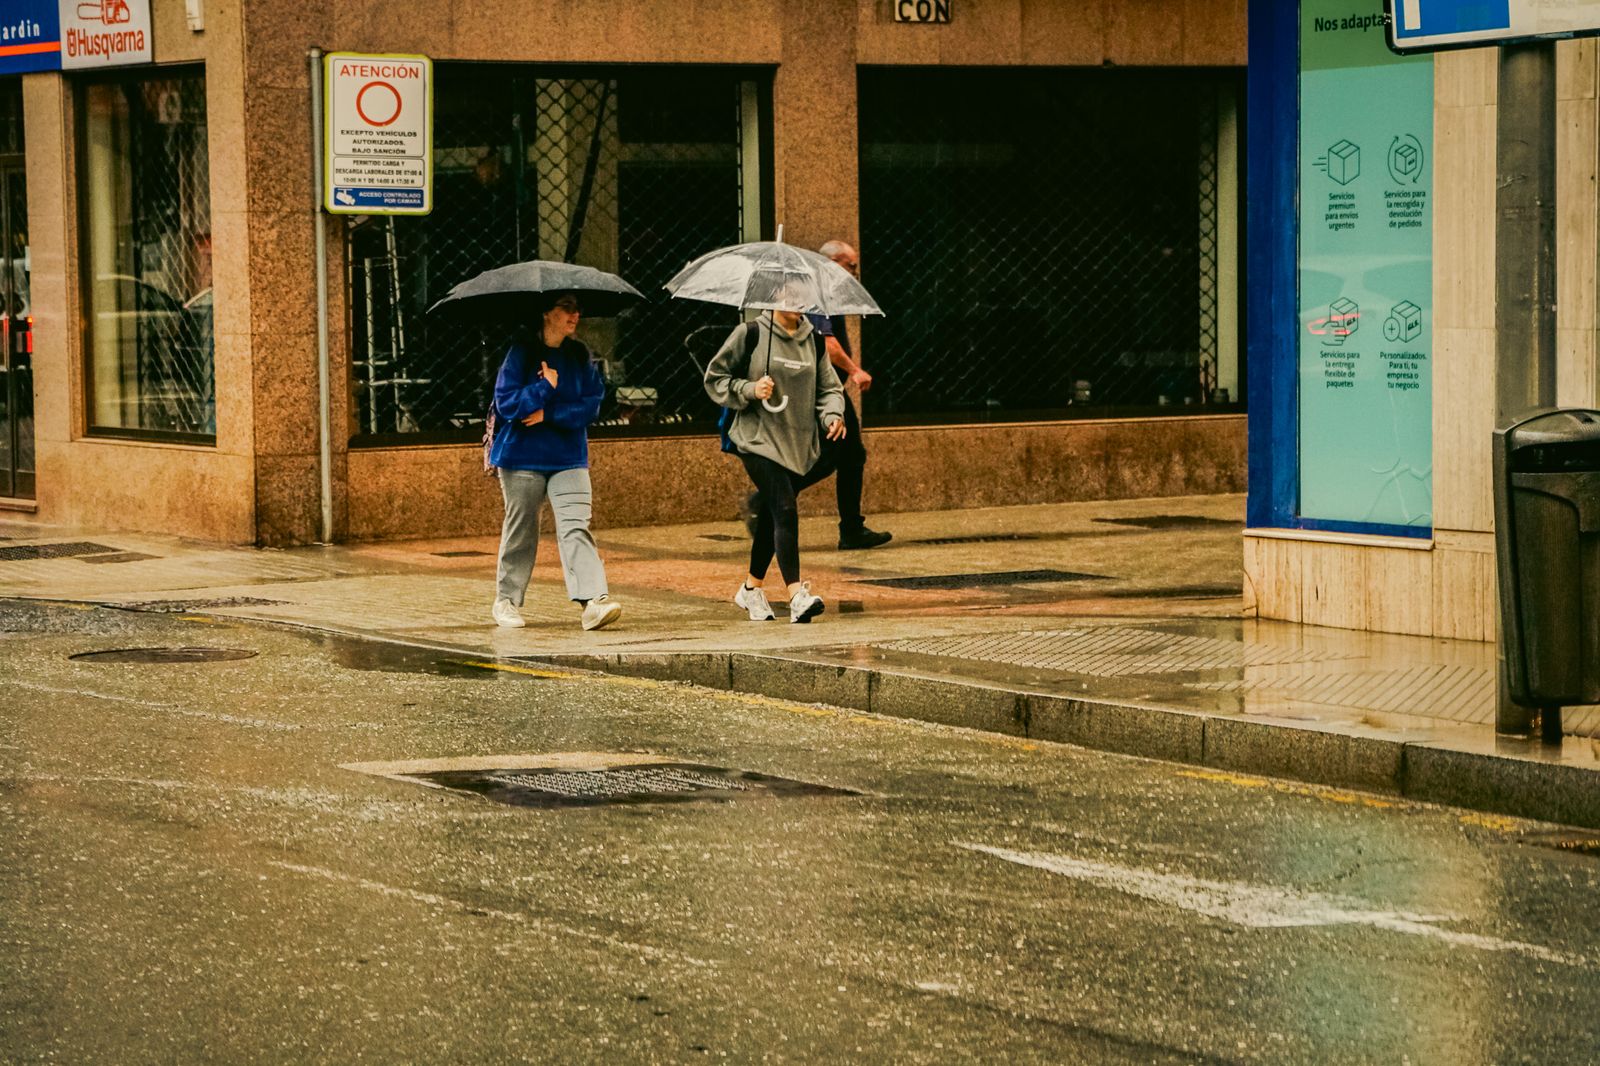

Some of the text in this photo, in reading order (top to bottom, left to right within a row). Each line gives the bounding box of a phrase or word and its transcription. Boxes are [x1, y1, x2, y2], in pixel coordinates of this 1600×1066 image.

[898, 0, 950, 23] CON
[1315, 17, 1338, 32] Nos
[0, 19, 40, 43] ardin
[77, 29, 145, 60] Husqvarna
[340, 63, 419, 79] ATENCIÓN
[1329, 192, 1355, 200] Servicios
[1384, 190, 1411, 198] Servicios
[1329, 203, 1355, 211] premium
[1387, 199, 1425, 209] la recogida y
[1325, 213, 1338, 221] para
[1329, 222, 1355, 231] urgentes
[1389, 219, 1422, 229] de pedidos
[1320, 350, 1360, 360] Servicios para
[1325, 360, 1355, 370] la entrega
[1389, 361, 1403, 369] Para
[1411, 362, 1418, 370] tu
[1325, 370, 1355, 378] flexible de
[1327, 380, 1354, 389] paquetes
[1395, 382, 1420, 391] negocio
